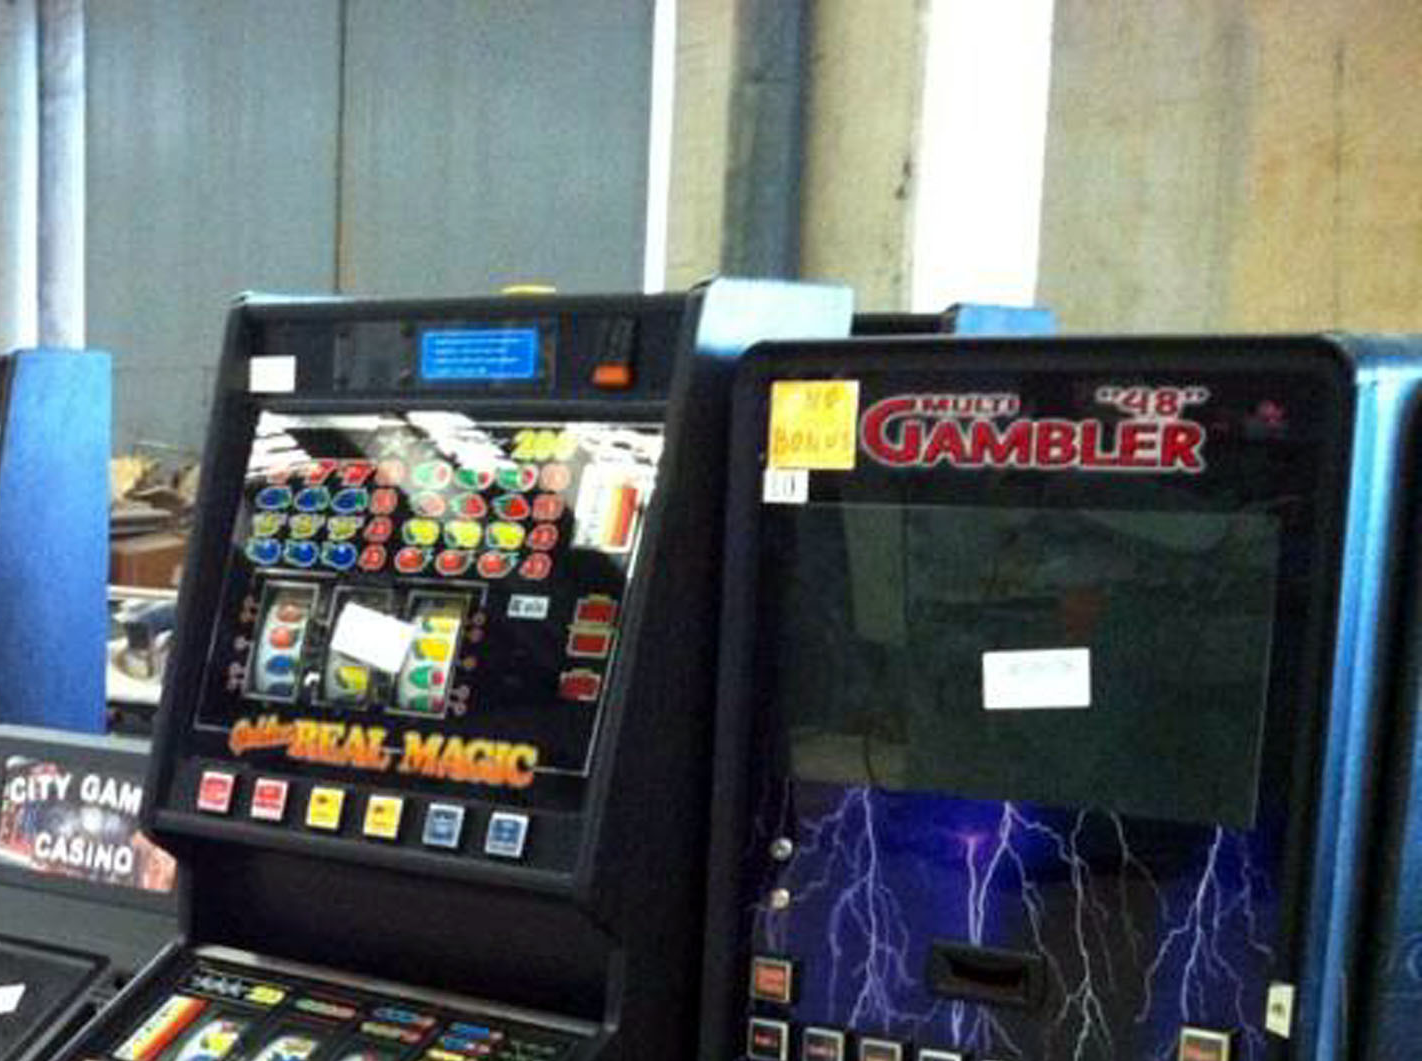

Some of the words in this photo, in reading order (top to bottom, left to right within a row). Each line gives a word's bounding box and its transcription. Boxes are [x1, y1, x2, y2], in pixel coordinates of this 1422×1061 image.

[912, 393, 1020, 416] MULTI
[860, 394, 1207, 473] GAMBLER
[287, 718, 391, 770] REAL
[397, 730, 538, 788] MAGIC
[9, 772, 72, 802] CITY
[34, 831, 133, 874] CASINO
